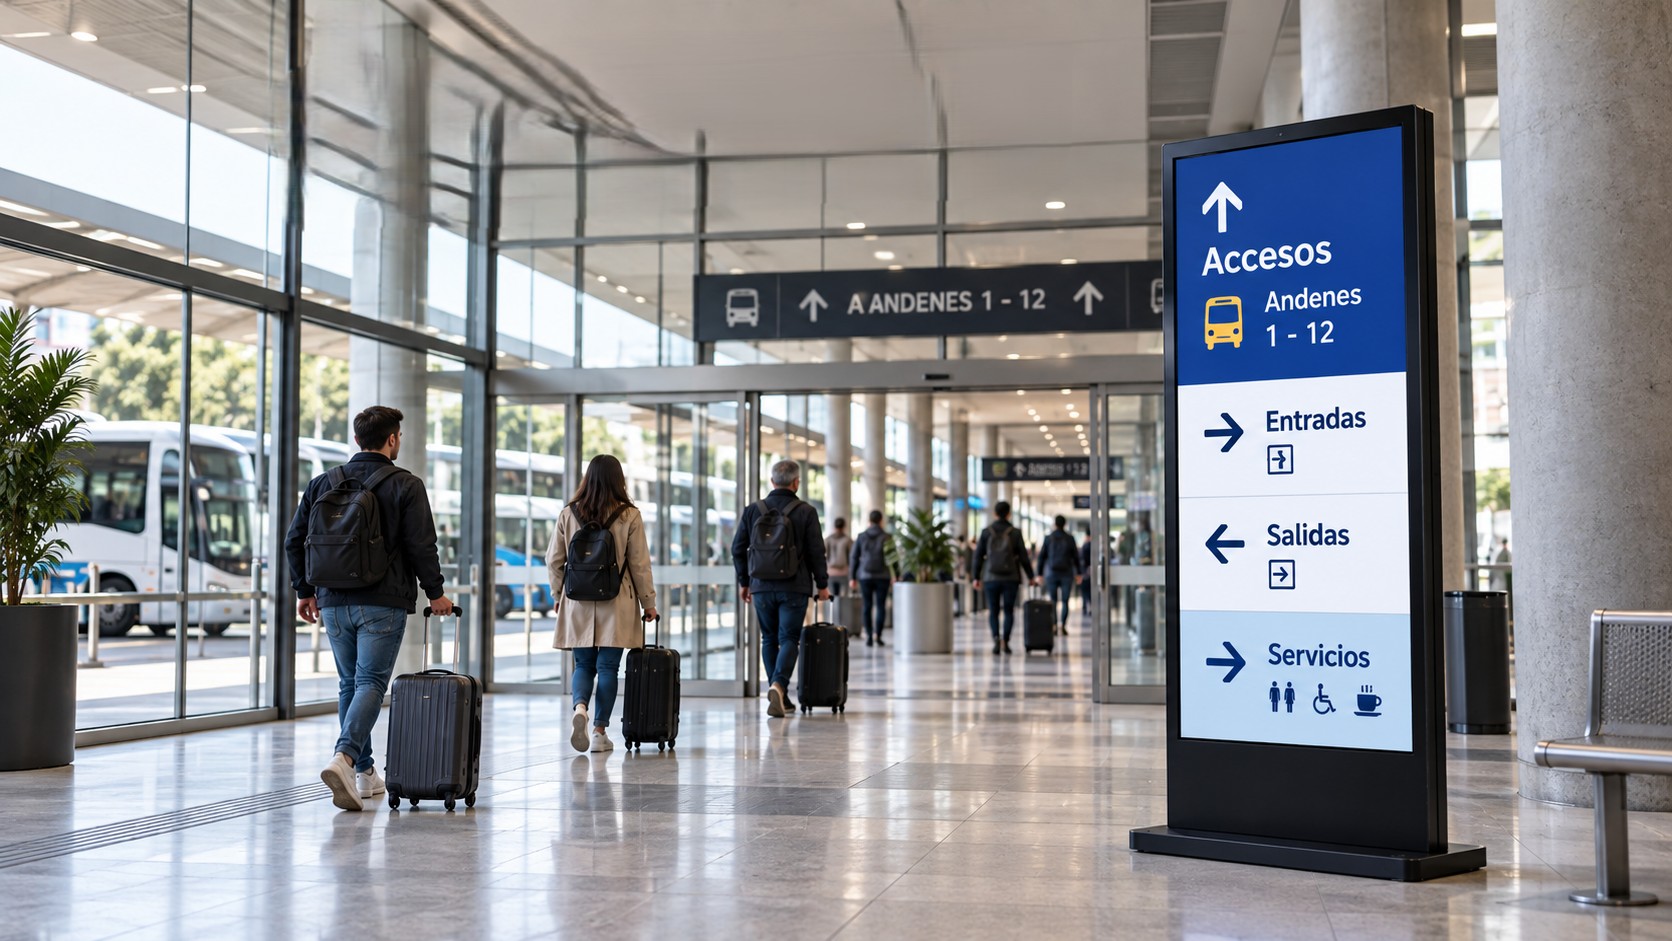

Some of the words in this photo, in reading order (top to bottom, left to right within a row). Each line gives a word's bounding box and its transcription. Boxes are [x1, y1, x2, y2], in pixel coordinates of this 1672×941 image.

[1201, 240, 1332, 277] Accesos
[847, 293, 865, 314] A
[868, 290, 973, 314] ANDENES
[981, 290, 992, 311] 1
[1019, 288, 1046, 310] 12
[1264, 287, 1362, 313] Andenes
[1266, 324, 1276, 347] 1
[1306, 320, 1334, 345] 12
[1266, 406, 1367, 433] Entradas
[1267, 522, 1350, 547] Salidas
[1268, 642, 1371, 669] Servicios
